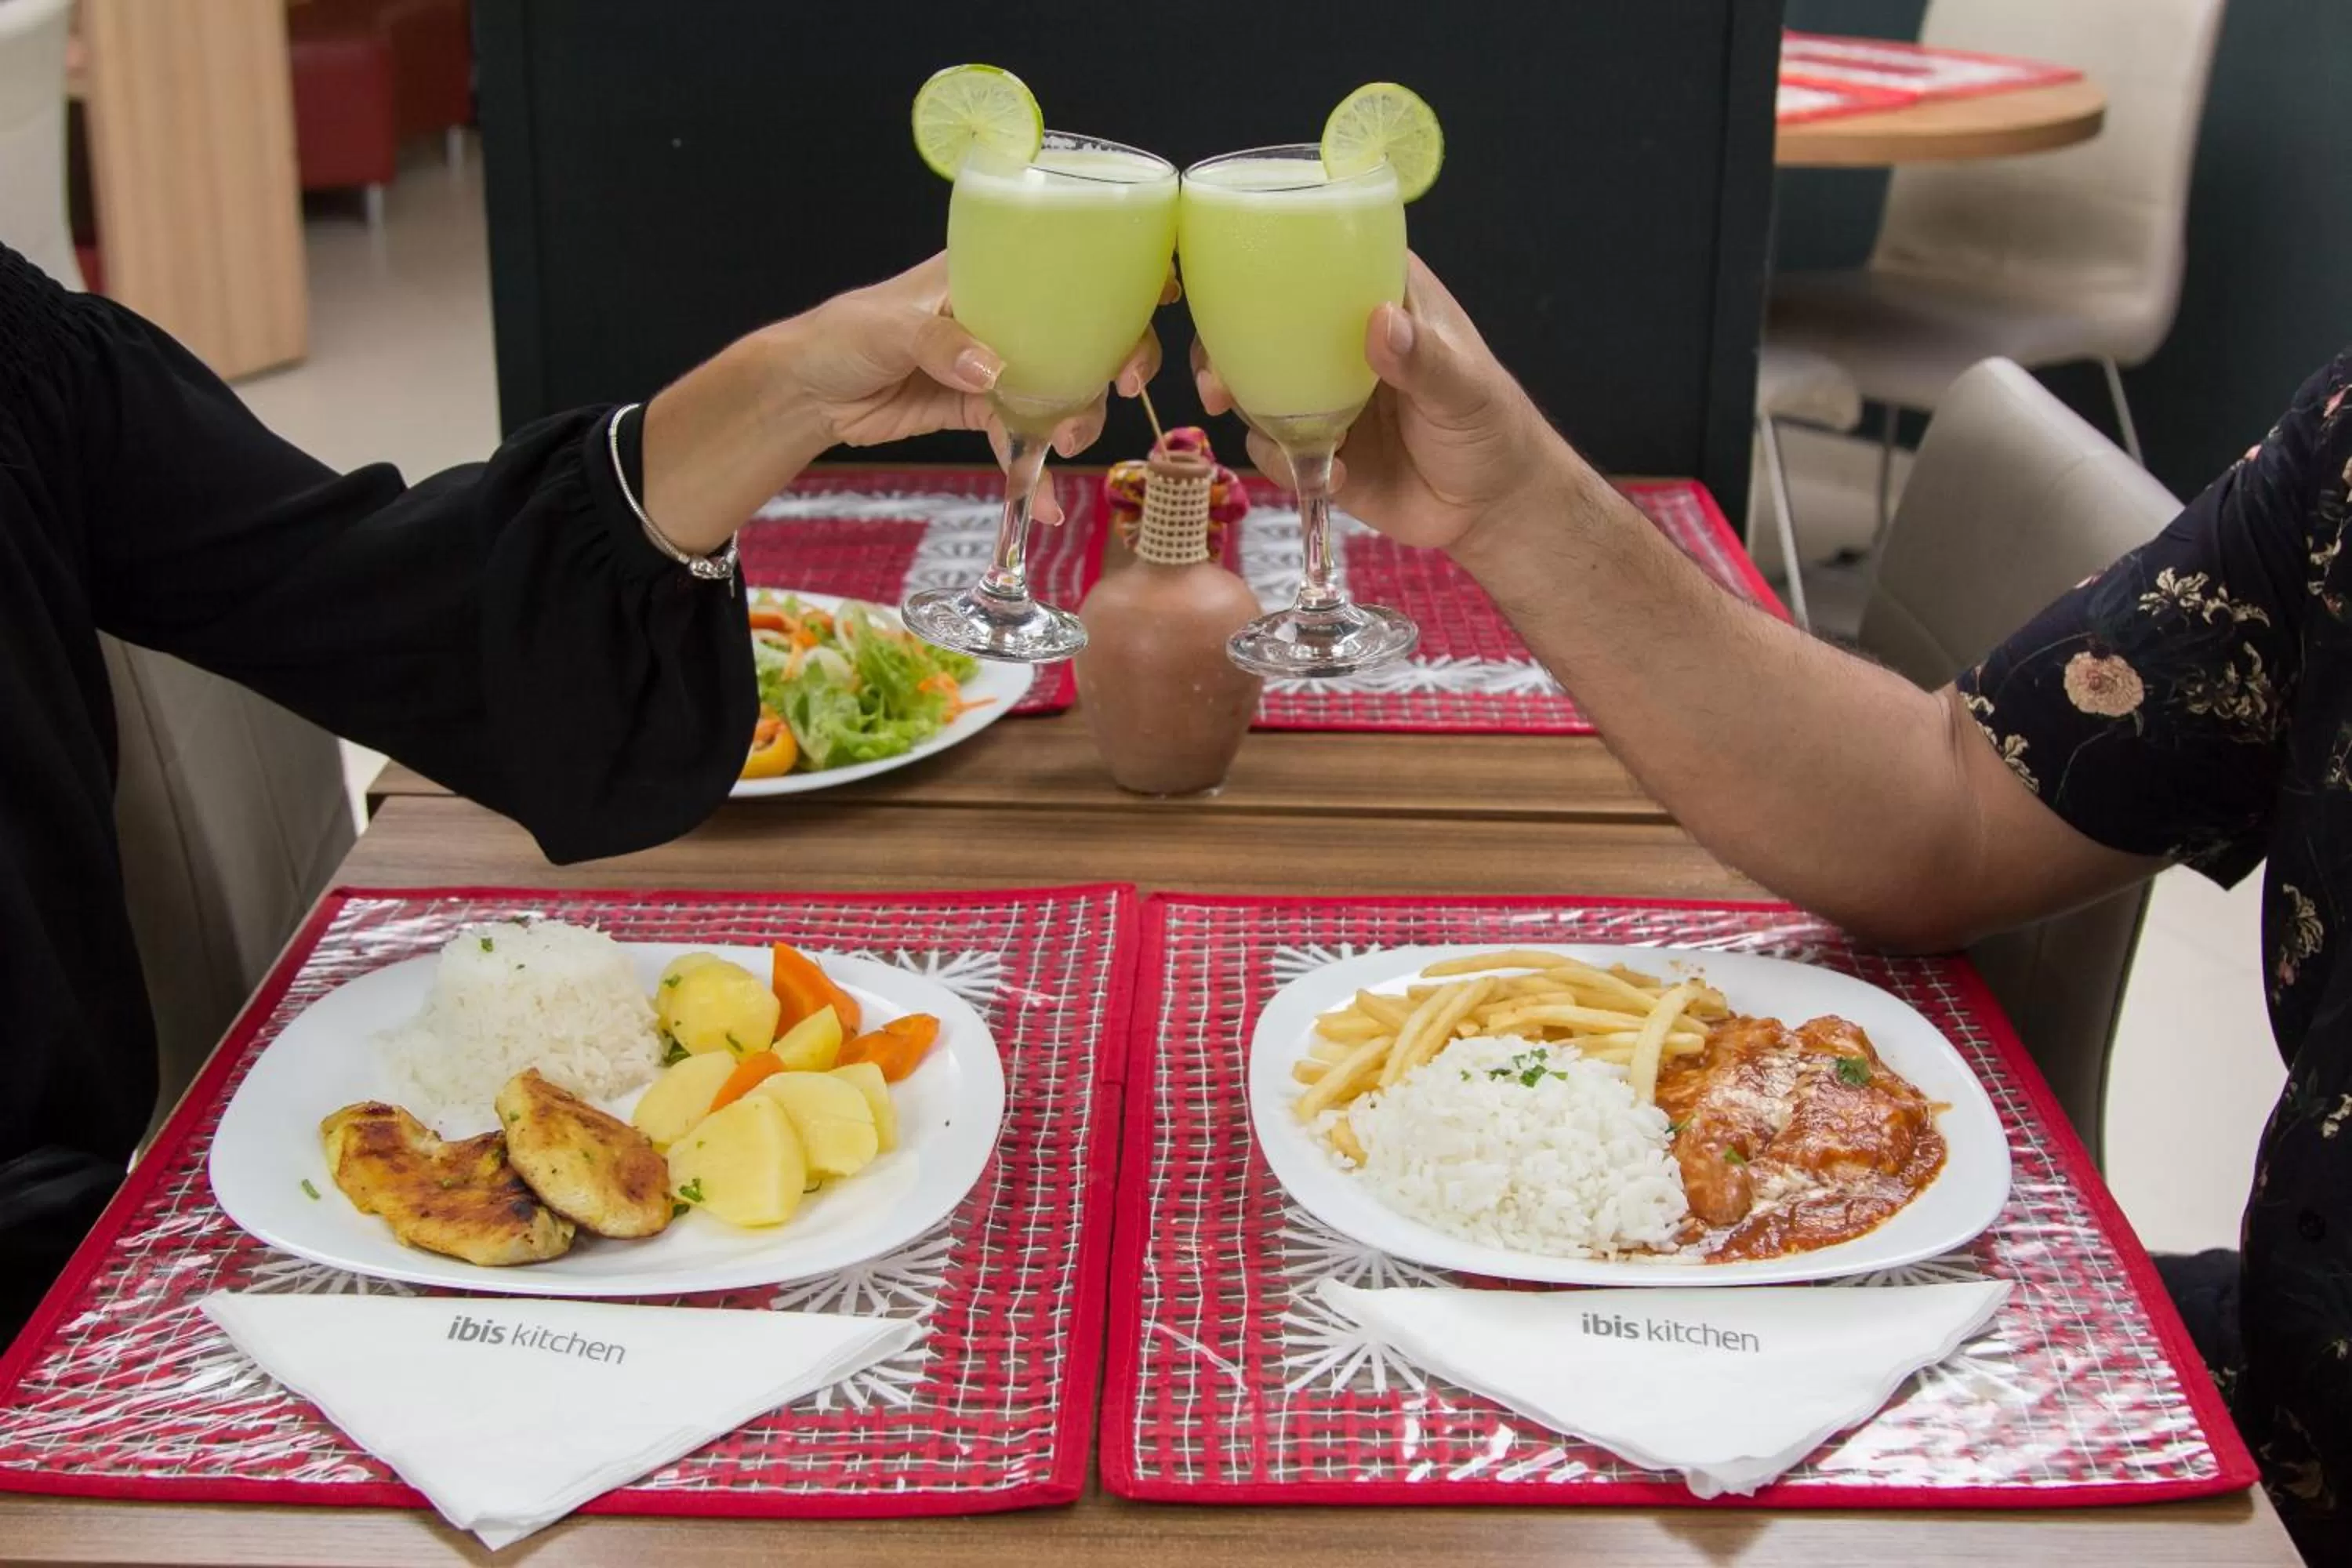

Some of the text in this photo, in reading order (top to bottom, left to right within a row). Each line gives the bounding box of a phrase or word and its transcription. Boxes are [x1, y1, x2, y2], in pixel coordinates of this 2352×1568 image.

[448, 1315, 626, 1364] ibis kitchen
[1581, 1312, 1759, 1352] ibis kitchen
